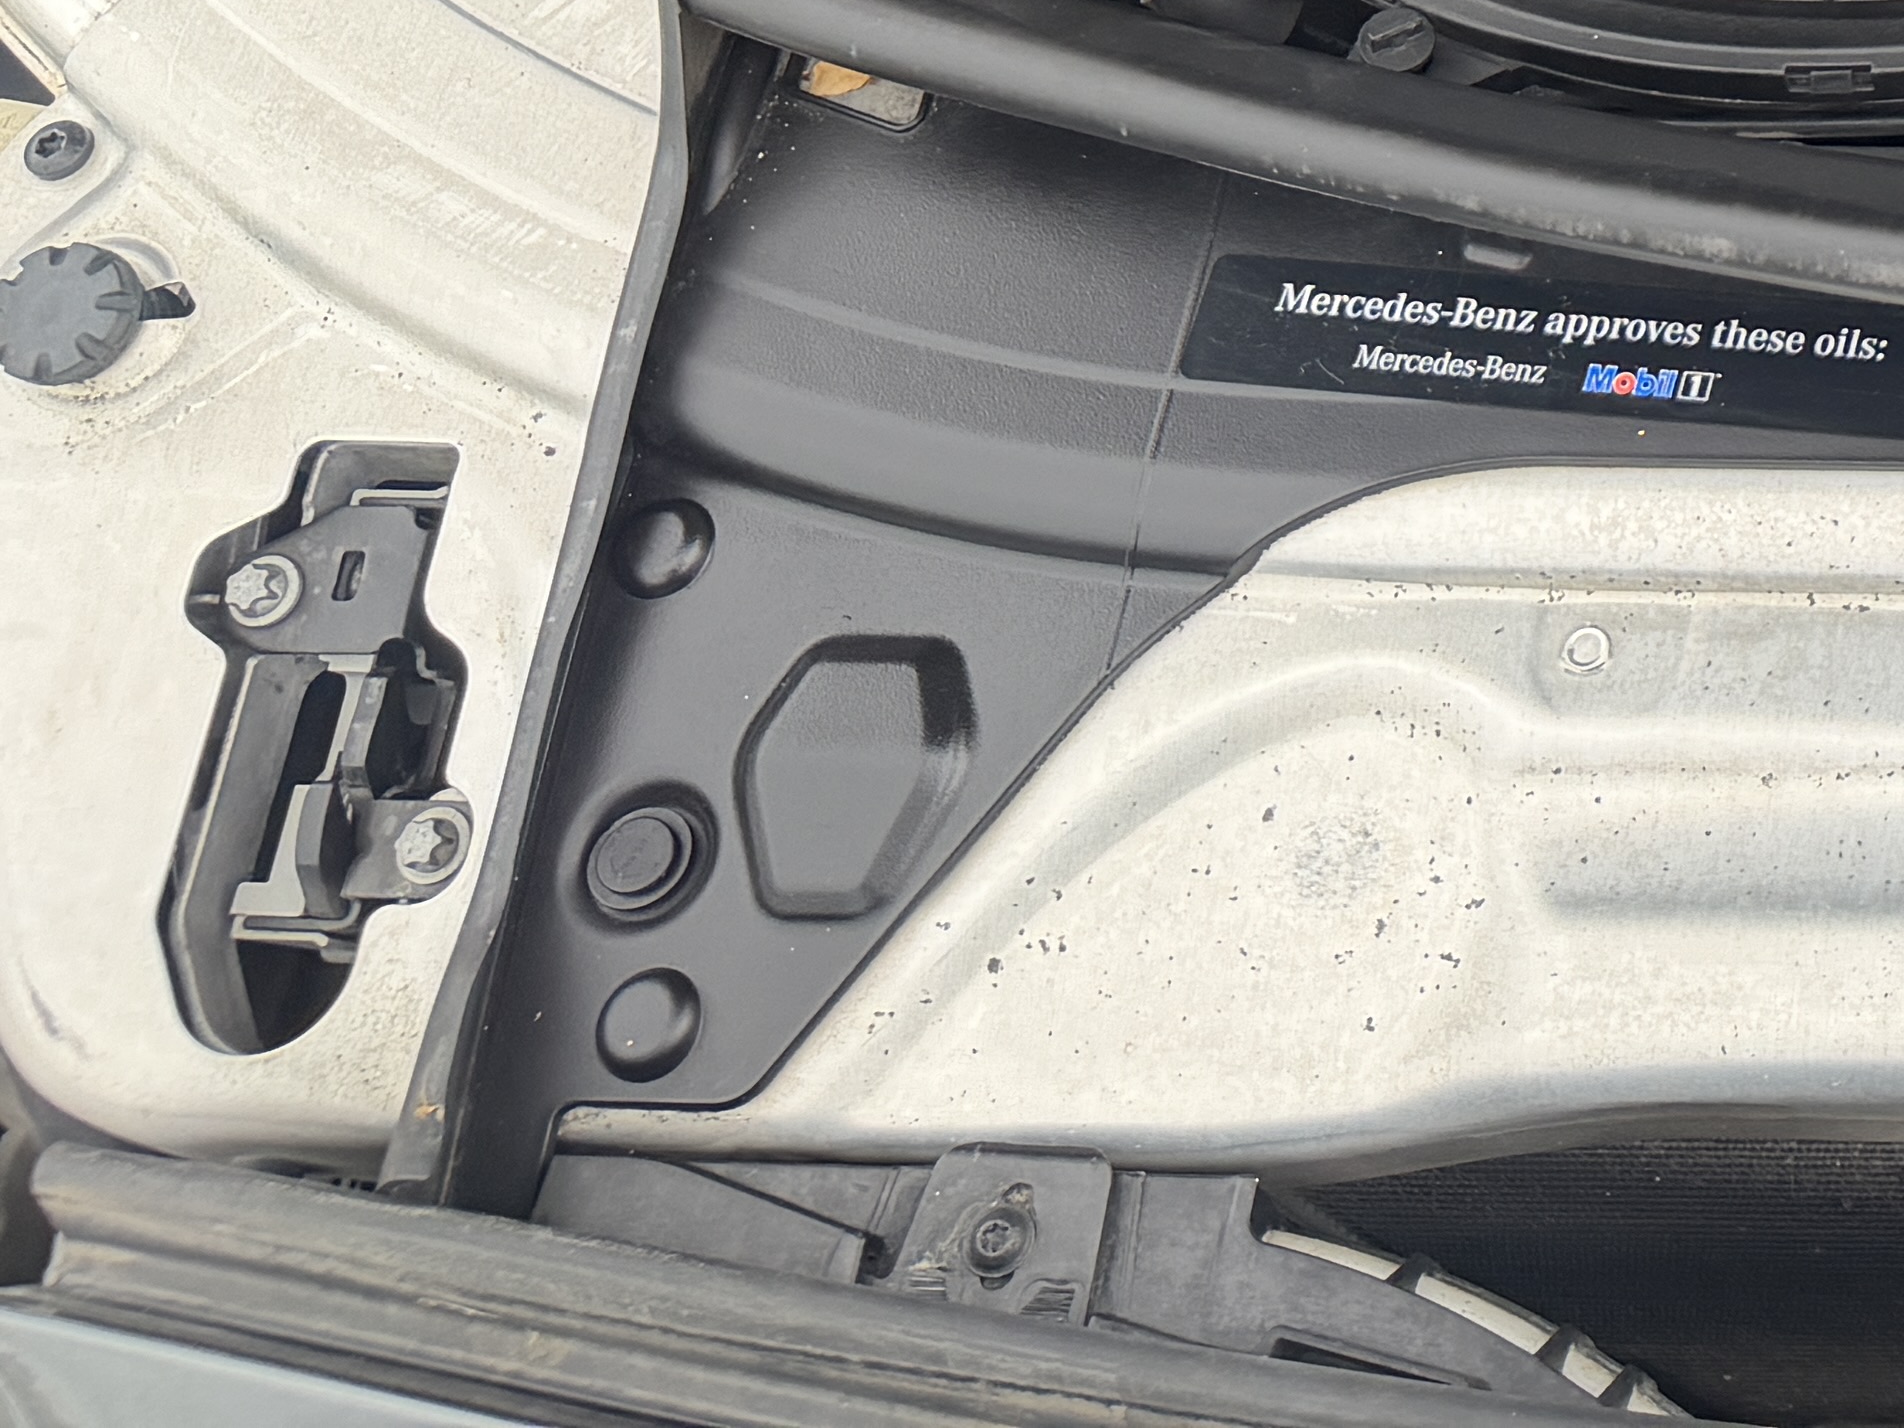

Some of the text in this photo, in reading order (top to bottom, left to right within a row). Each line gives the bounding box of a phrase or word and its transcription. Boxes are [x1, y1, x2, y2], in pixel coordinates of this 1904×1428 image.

[1274, 282, 1889, 362] Mercedes-Benz approves these oils:
[1352, 343, 1549, 384] Mercedes-Benz
[1582, 362, 1679, 399] Mobil
